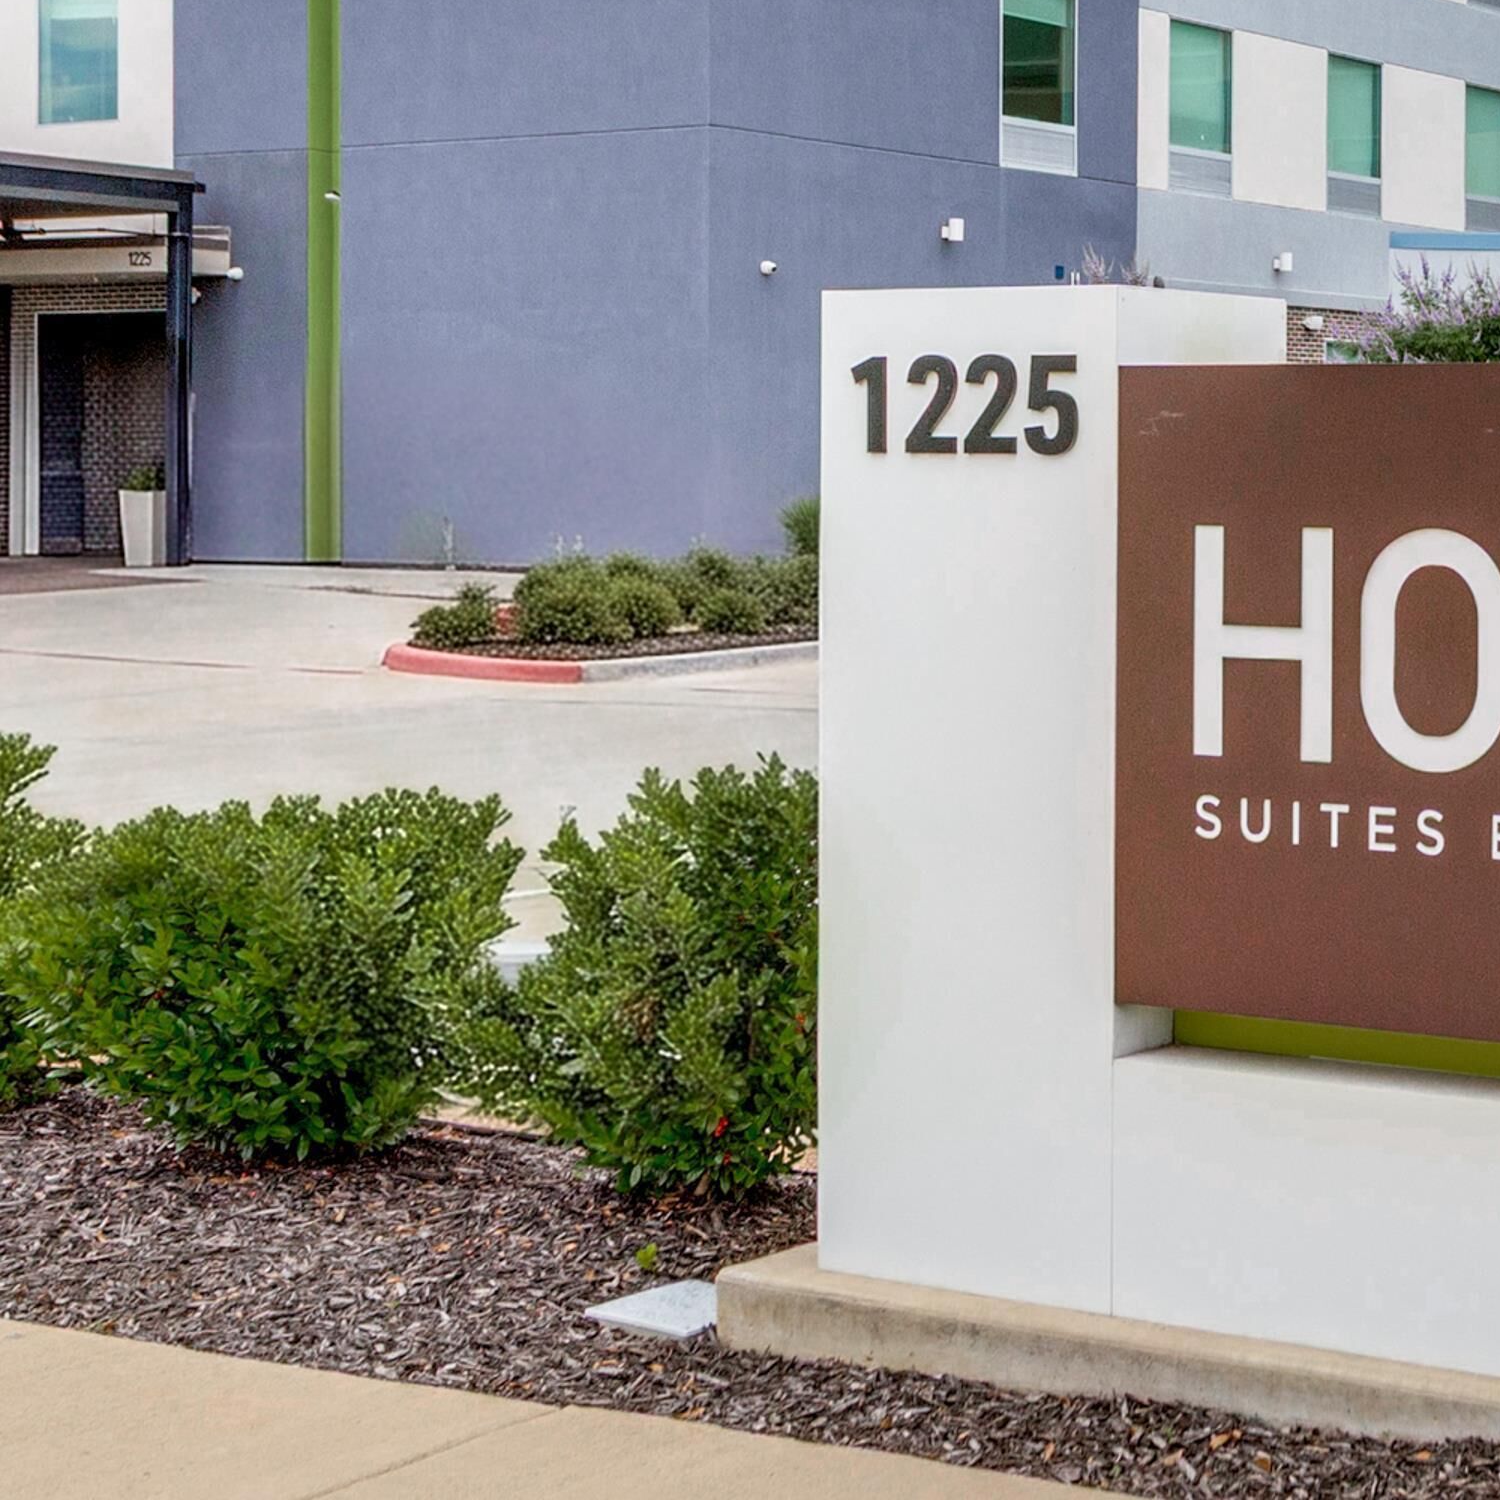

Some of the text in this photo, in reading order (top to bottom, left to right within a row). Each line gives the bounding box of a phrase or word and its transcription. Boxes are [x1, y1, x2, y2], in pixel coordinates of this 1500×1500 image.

[128, 251, 152, 266] 1225
[850, 353, 1080, 457] 1225
[1194, 793, 1446, 857] SUITES
